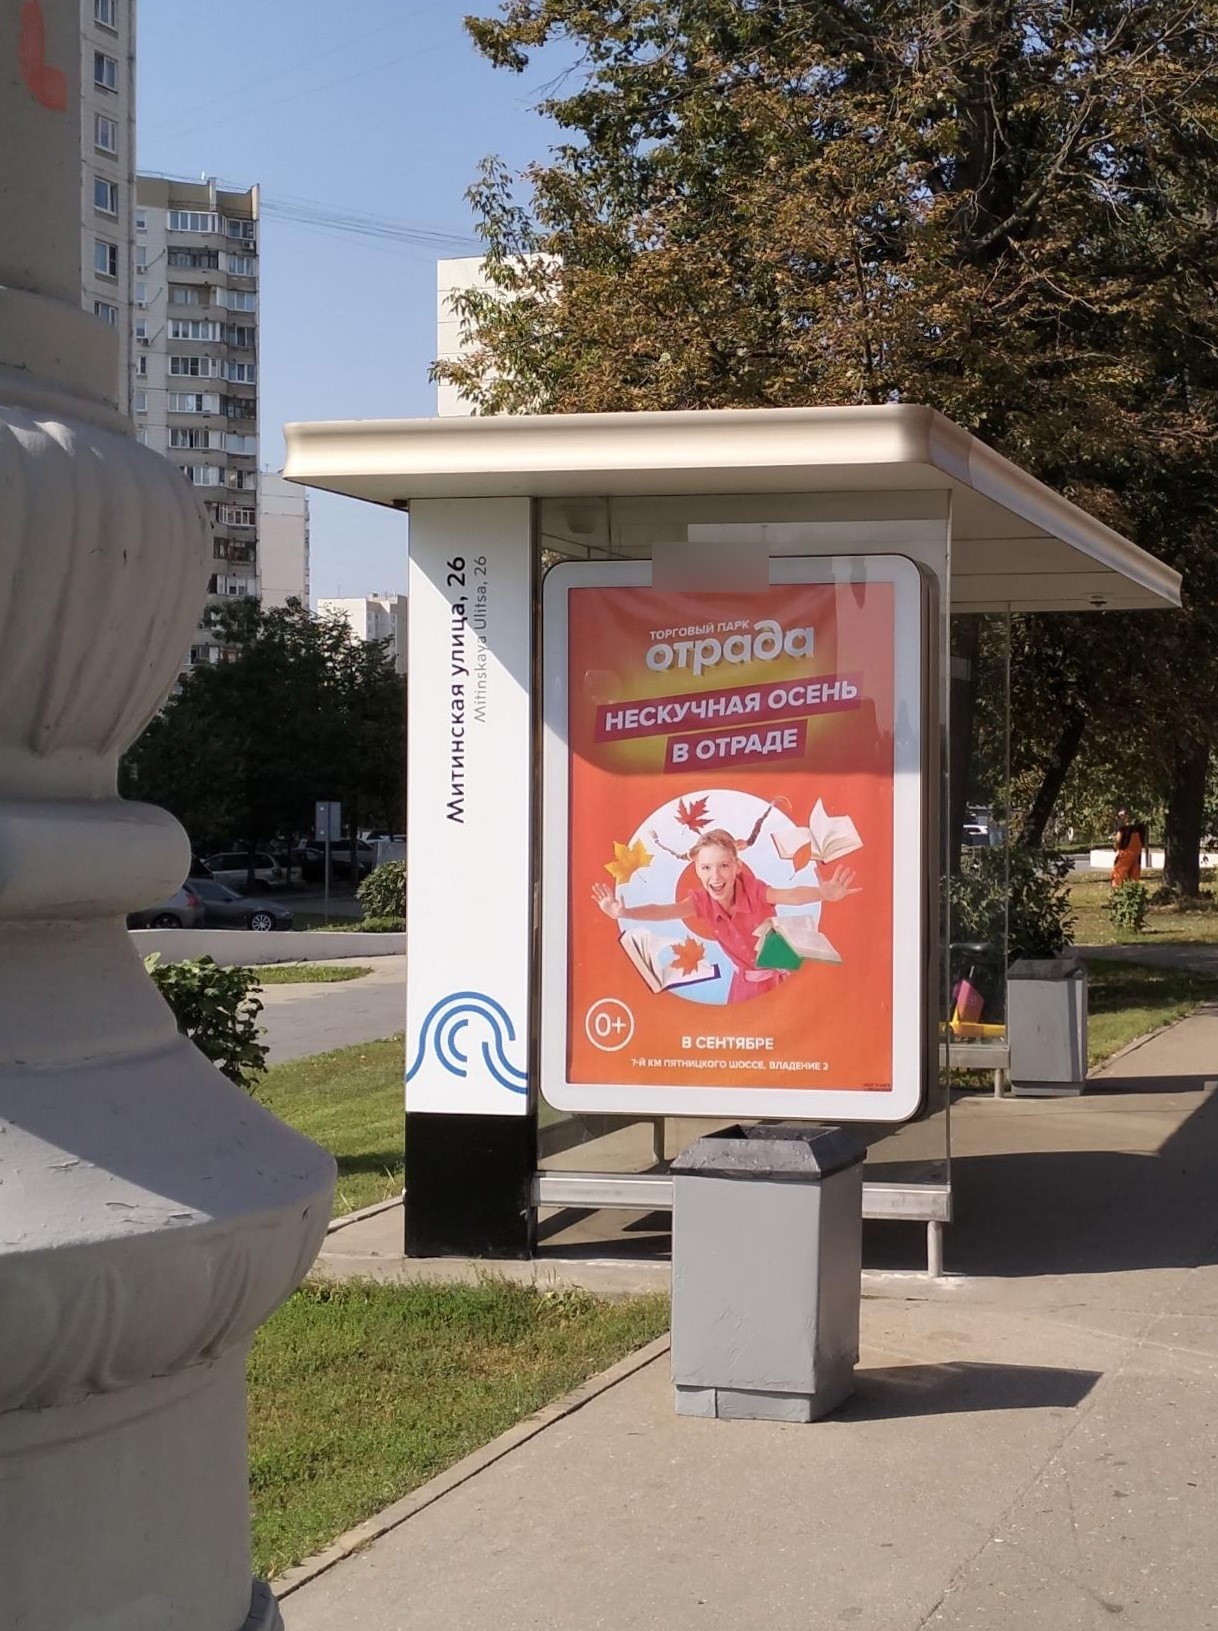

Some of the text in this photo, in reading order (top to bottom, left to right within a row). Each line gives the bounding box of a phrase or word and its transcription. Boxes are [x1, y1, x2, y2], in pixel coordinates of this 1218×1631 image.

[474, 556, 488, 723] Mitinskaya Ulitsa, 26
[650, 619, 750, 641] ТОРГОВЫЙ ПАРК
[646, 619, 815, 677] отрада
[446, 556, 469, 824] Митинская улица, 26
[605, 680, 858, 731] НЕСКУЧНАЯ ОСЕНЬ
[672, 728, 799, 763] В ОТРАДЕ
[594, 1012, 627, 1037] 0+
[681, 1036, 774, 1050] В СЕНТЯБРЕ
[630, 1058, 646, 1068] 7-Й
[647, 1059, 662, 1068] КМ
[663, 1059, 727, 1069] ПЯТНИЦКОГО
[769, 1061, 821, 1071] ВЛАДЕНИЕ
[822, 1062, 829, 1071] 2
